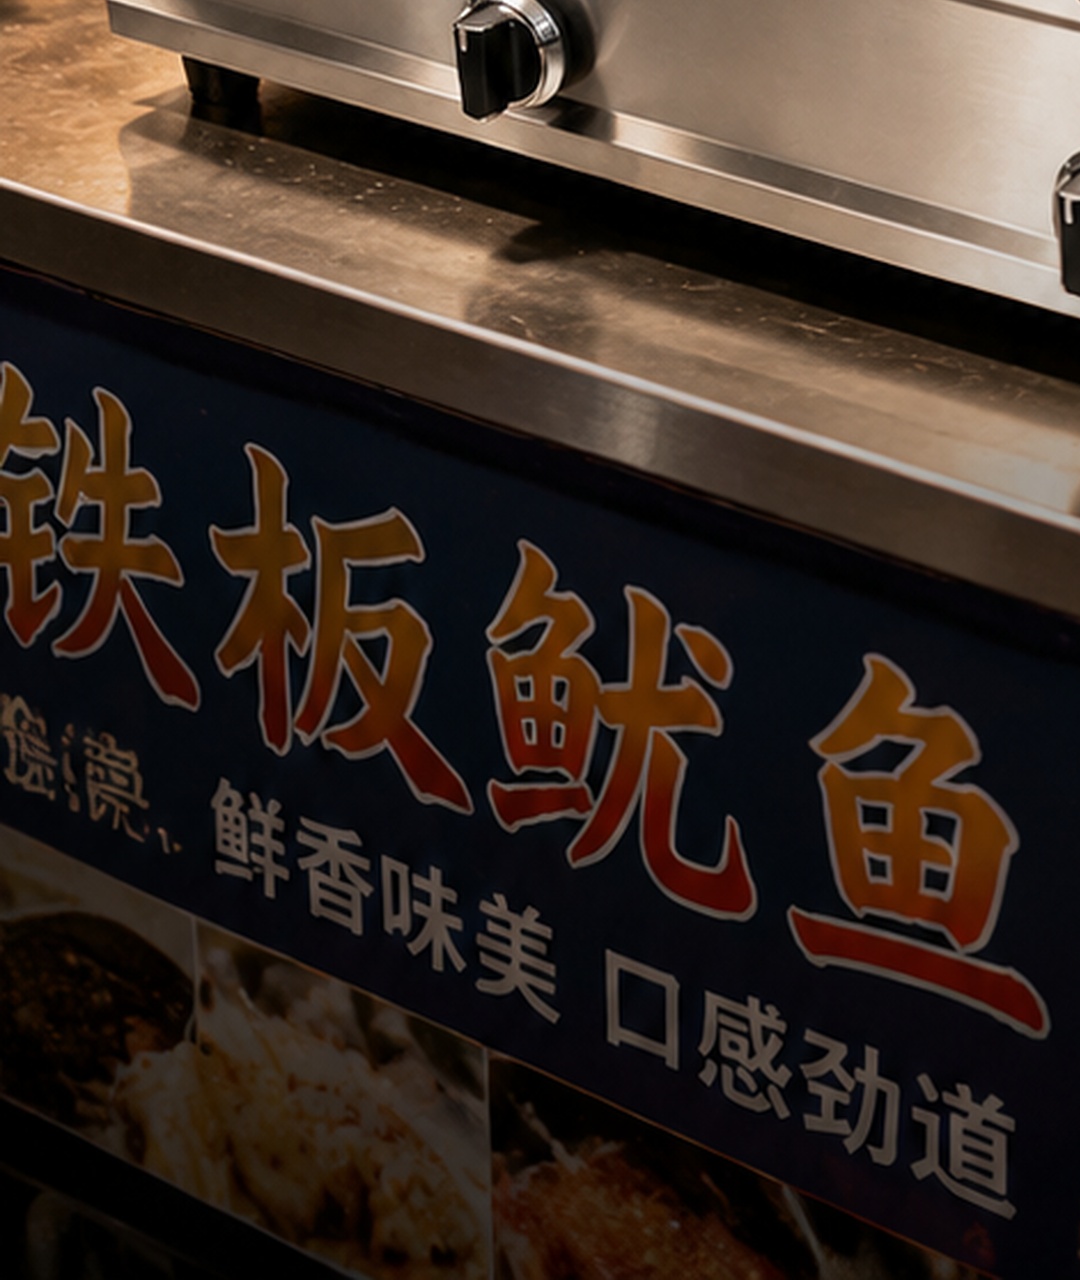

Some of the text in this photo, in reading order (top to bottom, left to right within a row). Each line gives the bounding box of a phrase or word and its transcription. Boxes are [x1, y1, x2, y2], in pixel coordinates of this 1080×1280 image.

[0, 361, 1050, 1039] 铁板鱿鱼
[210, 777, 1018, 1220] 鲜香味美 口感劲道
